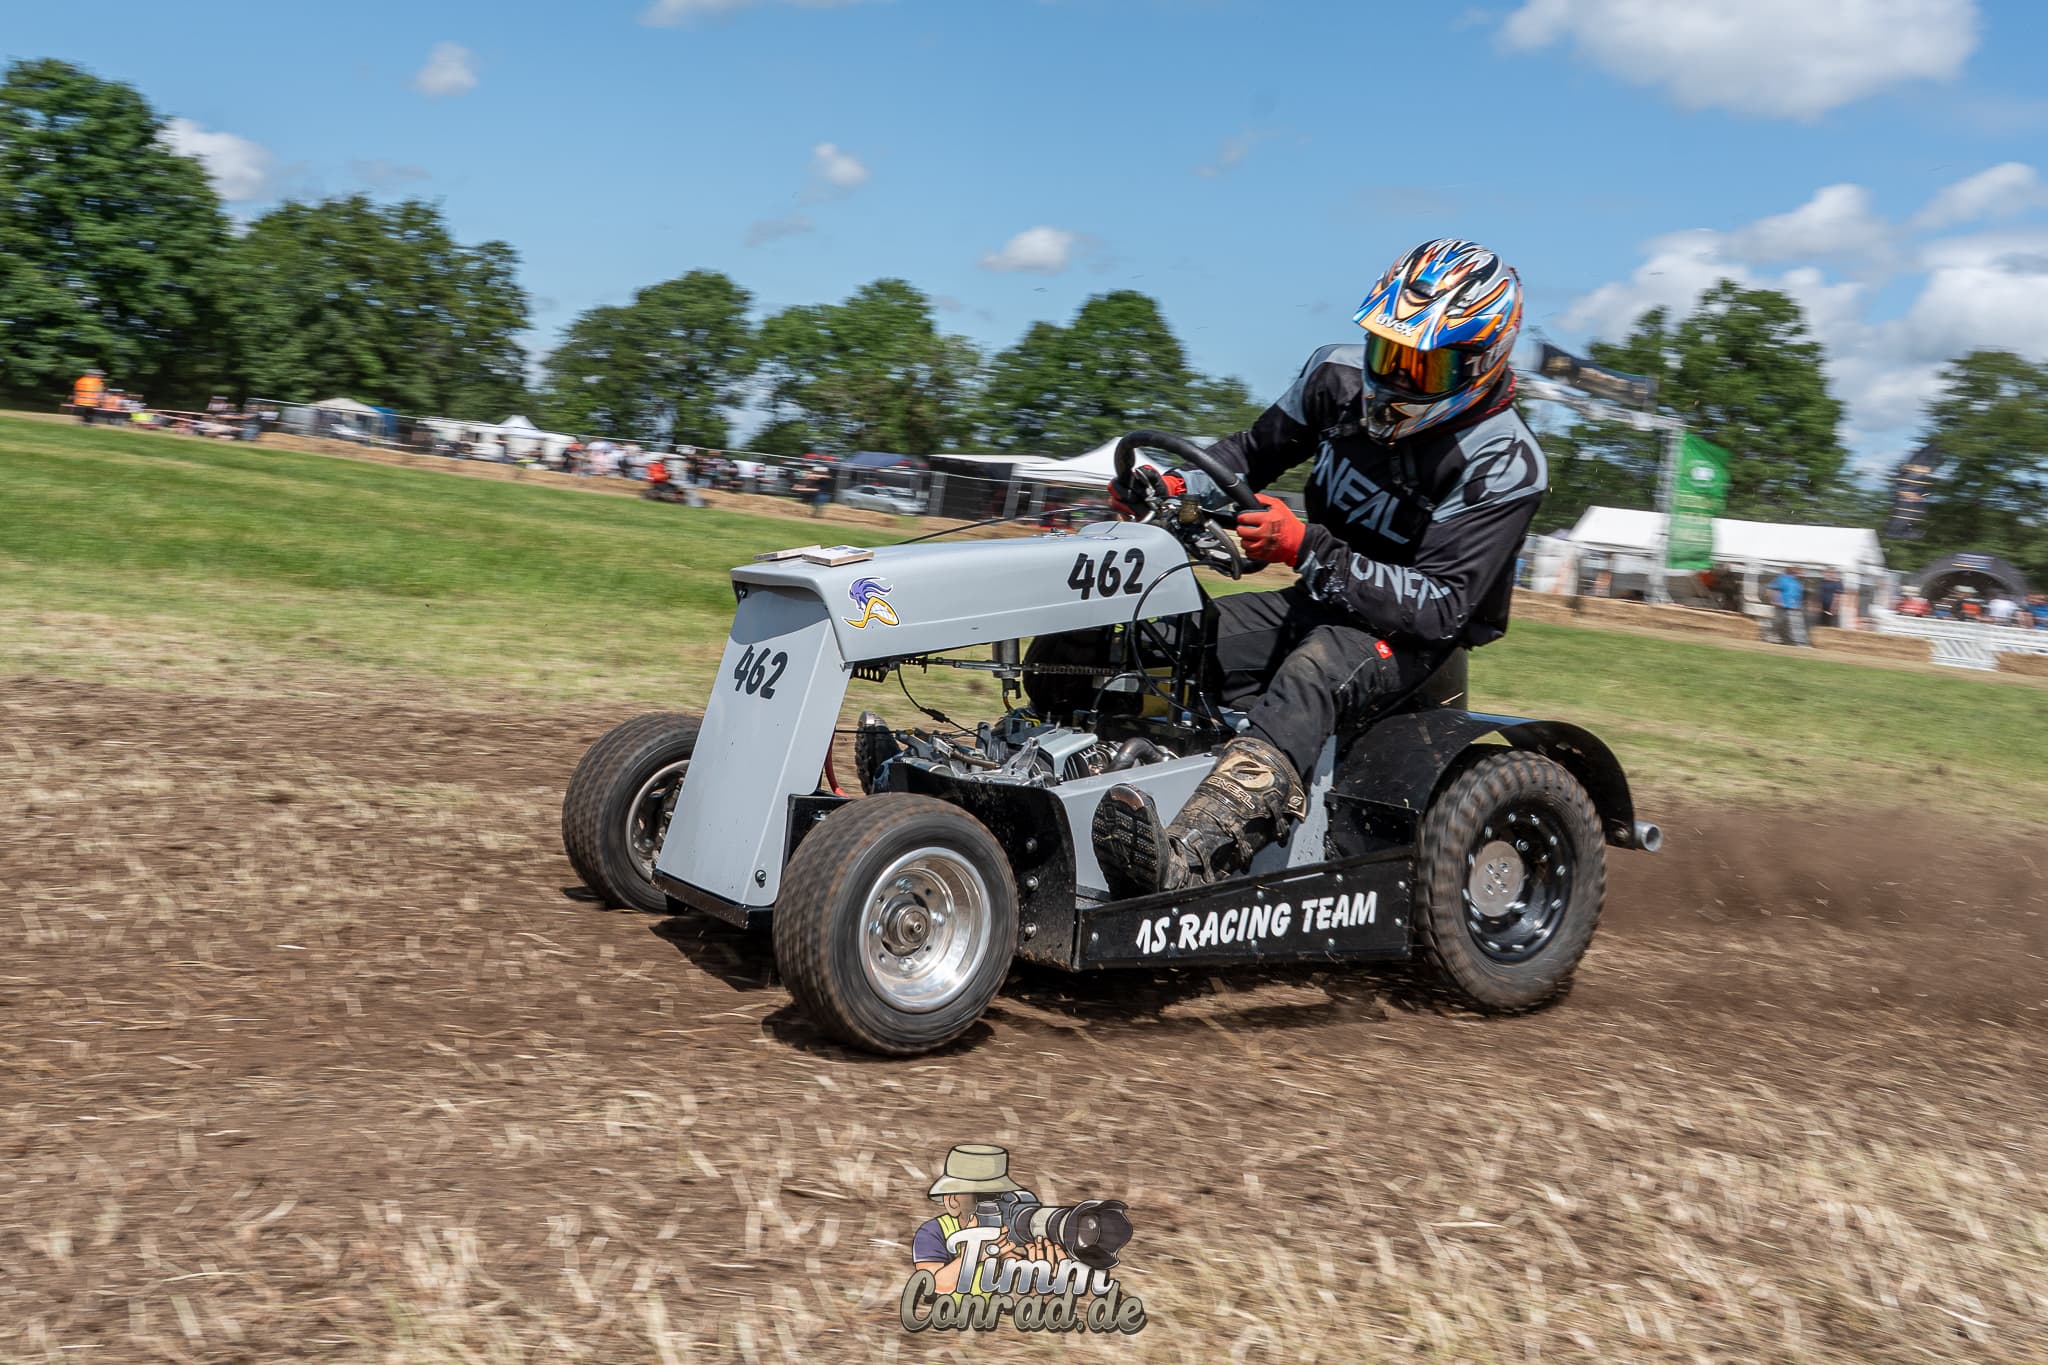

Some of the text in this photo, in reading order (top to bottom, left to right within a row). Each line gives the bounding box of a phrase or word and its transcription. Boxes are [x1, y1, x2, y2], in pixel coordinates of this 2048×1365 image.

[1375, 313, 1416, 337] uvex
[1067, 547, 1146, 600] 462
[733, 644, 789, 700] 462
[1177, 902, 1292, 951] RACING
[1301, 890, 1378, 933] TEAM
